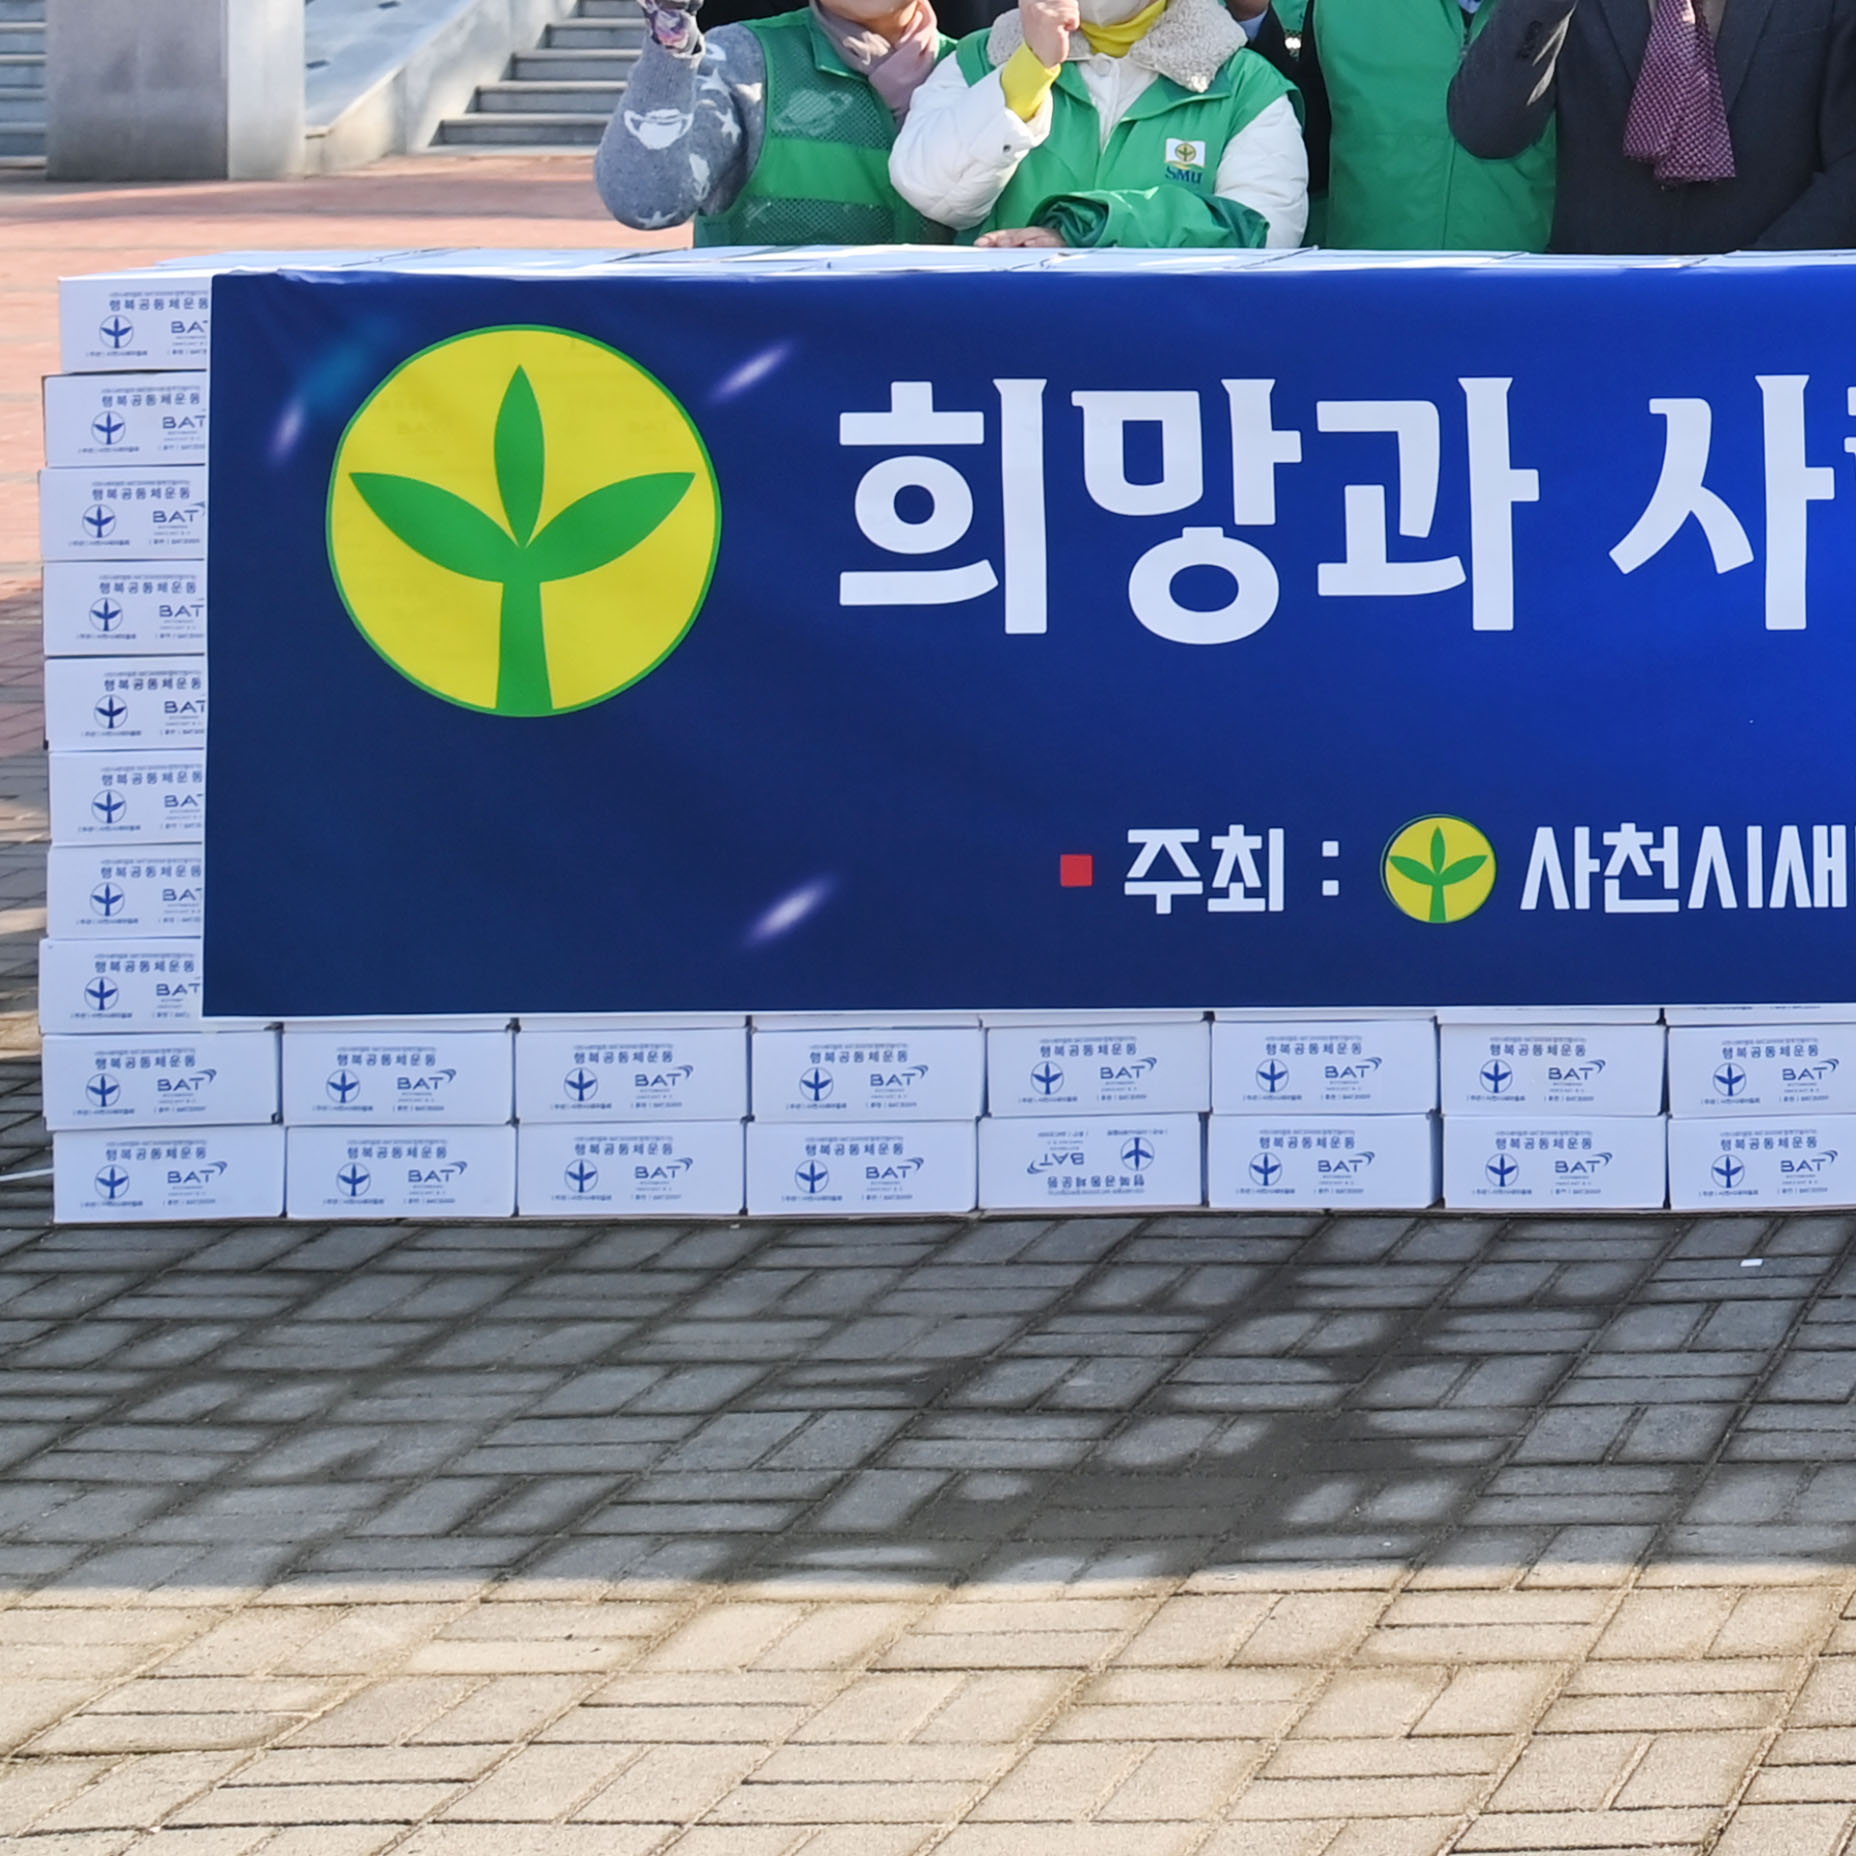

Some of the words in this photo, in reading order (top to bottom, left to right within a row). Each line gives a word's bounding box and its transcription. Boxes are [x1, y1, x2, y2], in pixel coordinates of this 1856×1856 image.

[1165, 165, 1203, 184] SMU
[840, 378, 1539, 644] 희망과
[1125, 825, 1285, 913] 주최
[571, 1049, 675, 1065] 행복공동체운동
[809, 1049, 909, 1064] 행복공동체운동
[1039, 1043, 1139, 1058] 행복공동체운동
[1264, 1041, 1364, 1056] 행복공동체운동
[1488, 1042, 1588, 1057] 행복공동체운동
[1721, 1044, 1821, 1059] 행복공동체운동
[93, 1054, 197, 1070] 행복공동체운동
[334, 1052, 438, 1068] 행복공동체운동
[633, 1069, 681, 1088] BAT
[870, 1069, 916, 1087] BAT
[1099, 1062, 1145, 1080] BAT
[1324, 1061, 1370, 1079] BAT
[1547, 1063, 1593, 1081] BAT
[1780, 1063, 1828, 1082] BAT
[156, 1073, 204, 1092] BAT
[396, 1072, 444, 1091] BAT
[574, 1141, 674, 1156] 행복공동체운동
[805, 1142, 905, 1157] 행복공동체운동
[1257, 1135, 1357, 1150] 행복공동체운동
[1494, 1136, 1594, 1151] 행복공동체운동
[1719, 1136, 1819, 1151] 행복공동체운동
[104, 1146, 208, 1162] 행복공동체운동
[345, 1144, 449, 1160] 행복공동체운동
[1039, 1152, 1085, 1167] BAT
[633, 1161, 681, 1180] BAT
[865, 1162, 911, 1180] BAT
[1318, 1156, 1361, 1173] BAT
[1554, 1156, 1600, 1174] BAT
[1780, 1155, 1826, 1173] BAT
[166, 1166, 214, 1185] BAT
[407, 1165, 455, 1184] BAT
